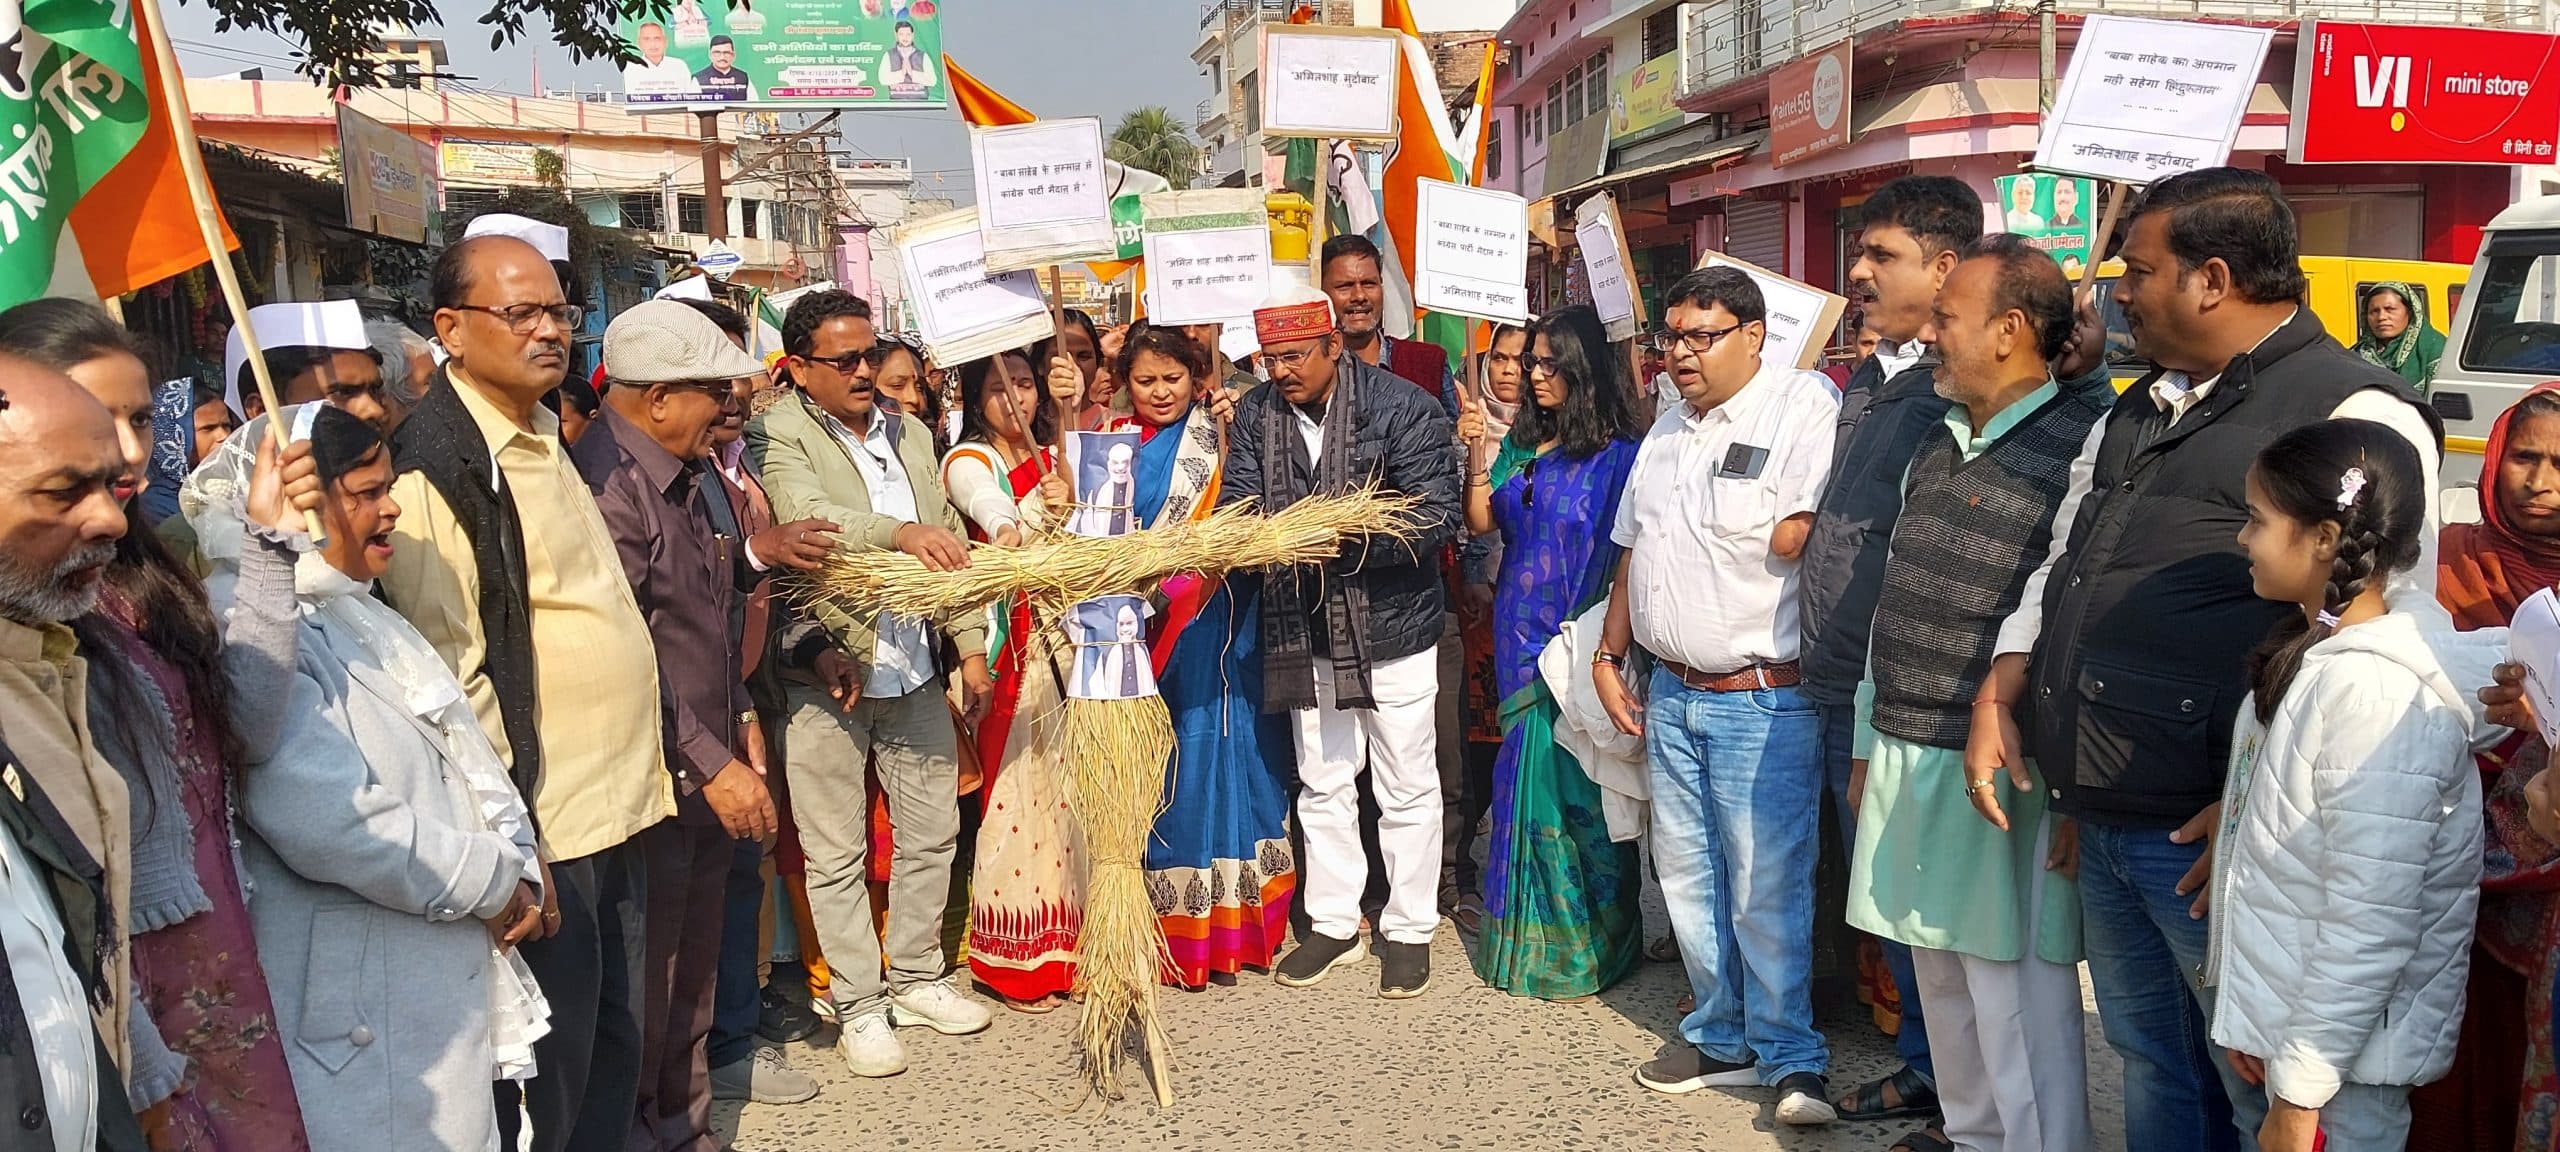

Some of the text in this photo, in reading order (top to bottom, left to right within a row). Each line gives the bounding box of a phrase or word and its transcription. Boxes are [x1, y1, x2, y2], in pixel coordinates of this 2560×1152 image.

[829, 43, 846, 52] का
[2192, 59, 2237, 73] अपमान
[2129, 76, 2160, 91] सहेगा
[2445, 72, 2529, 97] mini store
[1779, 90, 1811, 119] airtel 5G
[2503, 138, 2553, 156] वी मिनी स्टोर
[1028, 184, 1044, 196] पार्टी
[1048, 183, 1069, 195] मैदान
[1460, 243, 1474, 255] पार्टी
[1197, 258, 1212, 267] शाह
[1771, 311, 1800, 327] अपमान
